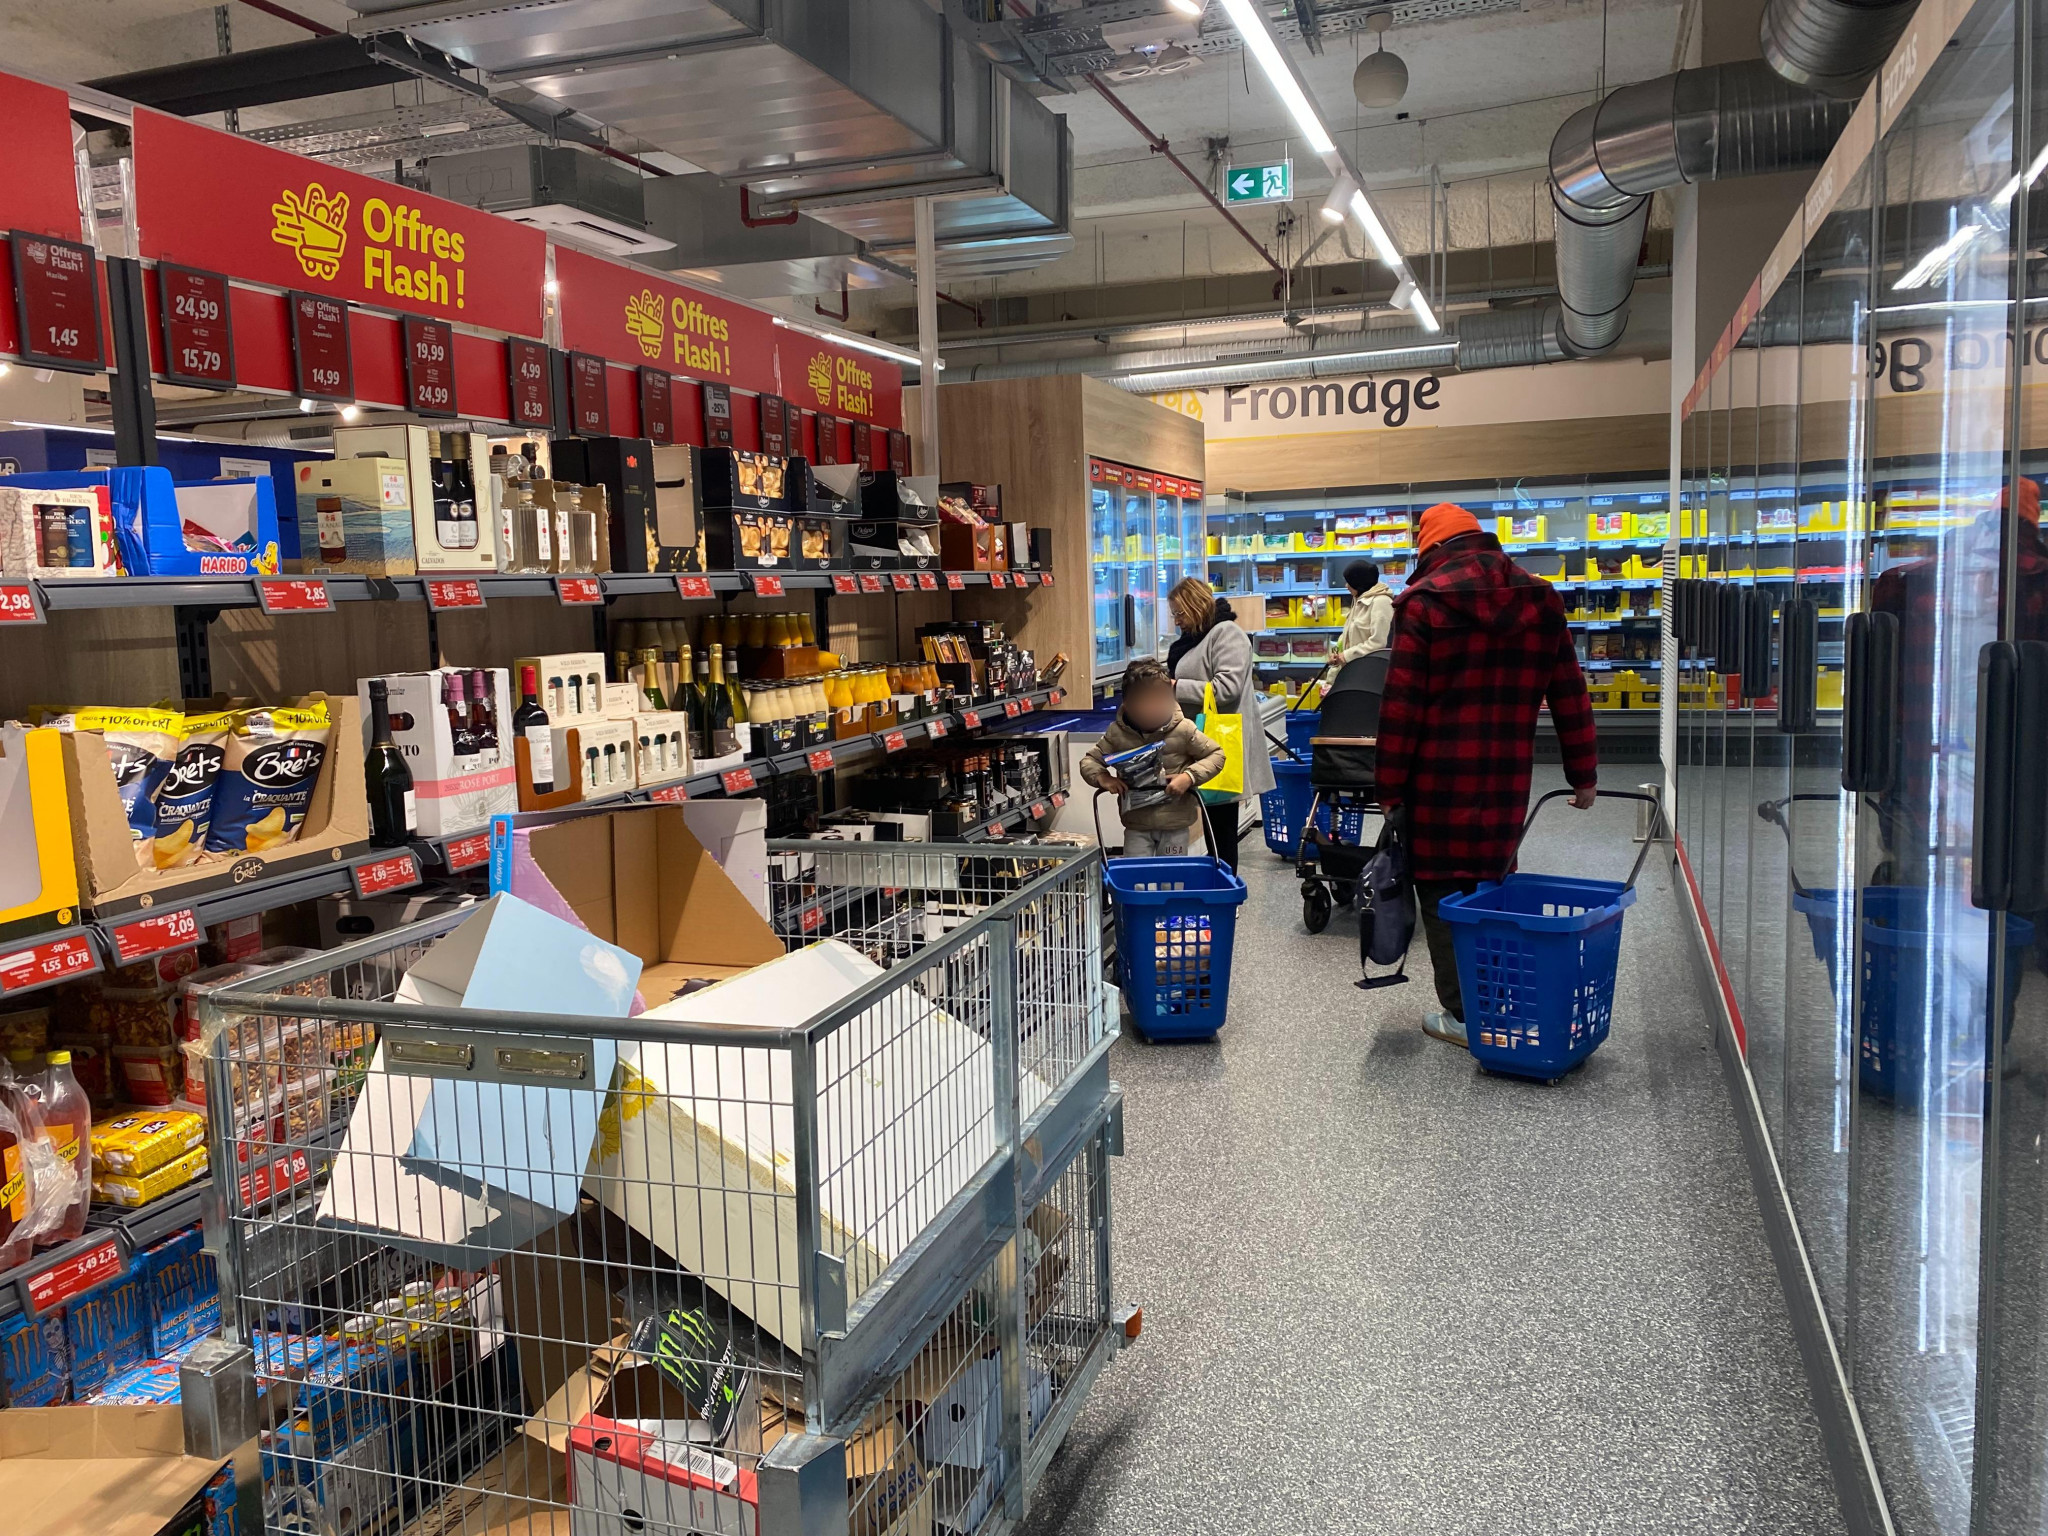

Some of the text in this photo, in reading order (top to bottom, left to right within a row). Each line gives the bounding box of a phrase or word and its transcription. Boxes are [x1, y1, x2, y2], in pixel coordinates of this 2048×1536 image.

[1881, 32, 1918, 117] PIZZAS
[363, 197, 466, 263] Offres
[50, 245, 83, 261] Offres
[51, 257, 78, 272] Flash
[364, 246, 449, 306] Flash
[176, 295, 219, 320] 24,99
[316, 301, 339, 314] Offres
[317, 311, 336, 321] Flash
[671, 297, 729, 341] Offres
[49, 326, 79, 346] 1,45
[182, 348, 221, 371] 15,79
[416, 342, 444, 362] 19,99
[673, 333, 722, 374] Flash
[312, 368, 340, 386] 14,99
[521, 362, 541, 379] 4,99
[836, 357, 872, 390] Offres
[419, 385, 448, 404] 24,99
[837, 386, 868, 416] Flash
[1224, 376, 1441, 427] Fromage
[524, 401, 542, 418] 8,39
[585, 411, 599, 425] 1,69
[201, 556, 247, 574] HARIBO
[0, 594, 31, 612] 2,98
[305, 587, 325, 601] 2,85
[252, 790, 307, 804] CRAQUANTE
[1165, 846, 1183, 855] USA
[372, 869, 387, 881] 1,99
[400, 863, 413, 876] 1,75
[493, 851, 504, 885] always
[168, 917, 195, 937] 2,09
[50, 942, 71, 953] -50%
[41, 958, 61, 974] 1,55
[67, 951, 89, 966] 0,78
[98, 1246, 118, 1264] 2,75
[78, 1257, 97, 1274] 5,49
[160, 1310, 189, 1331] JUICED
